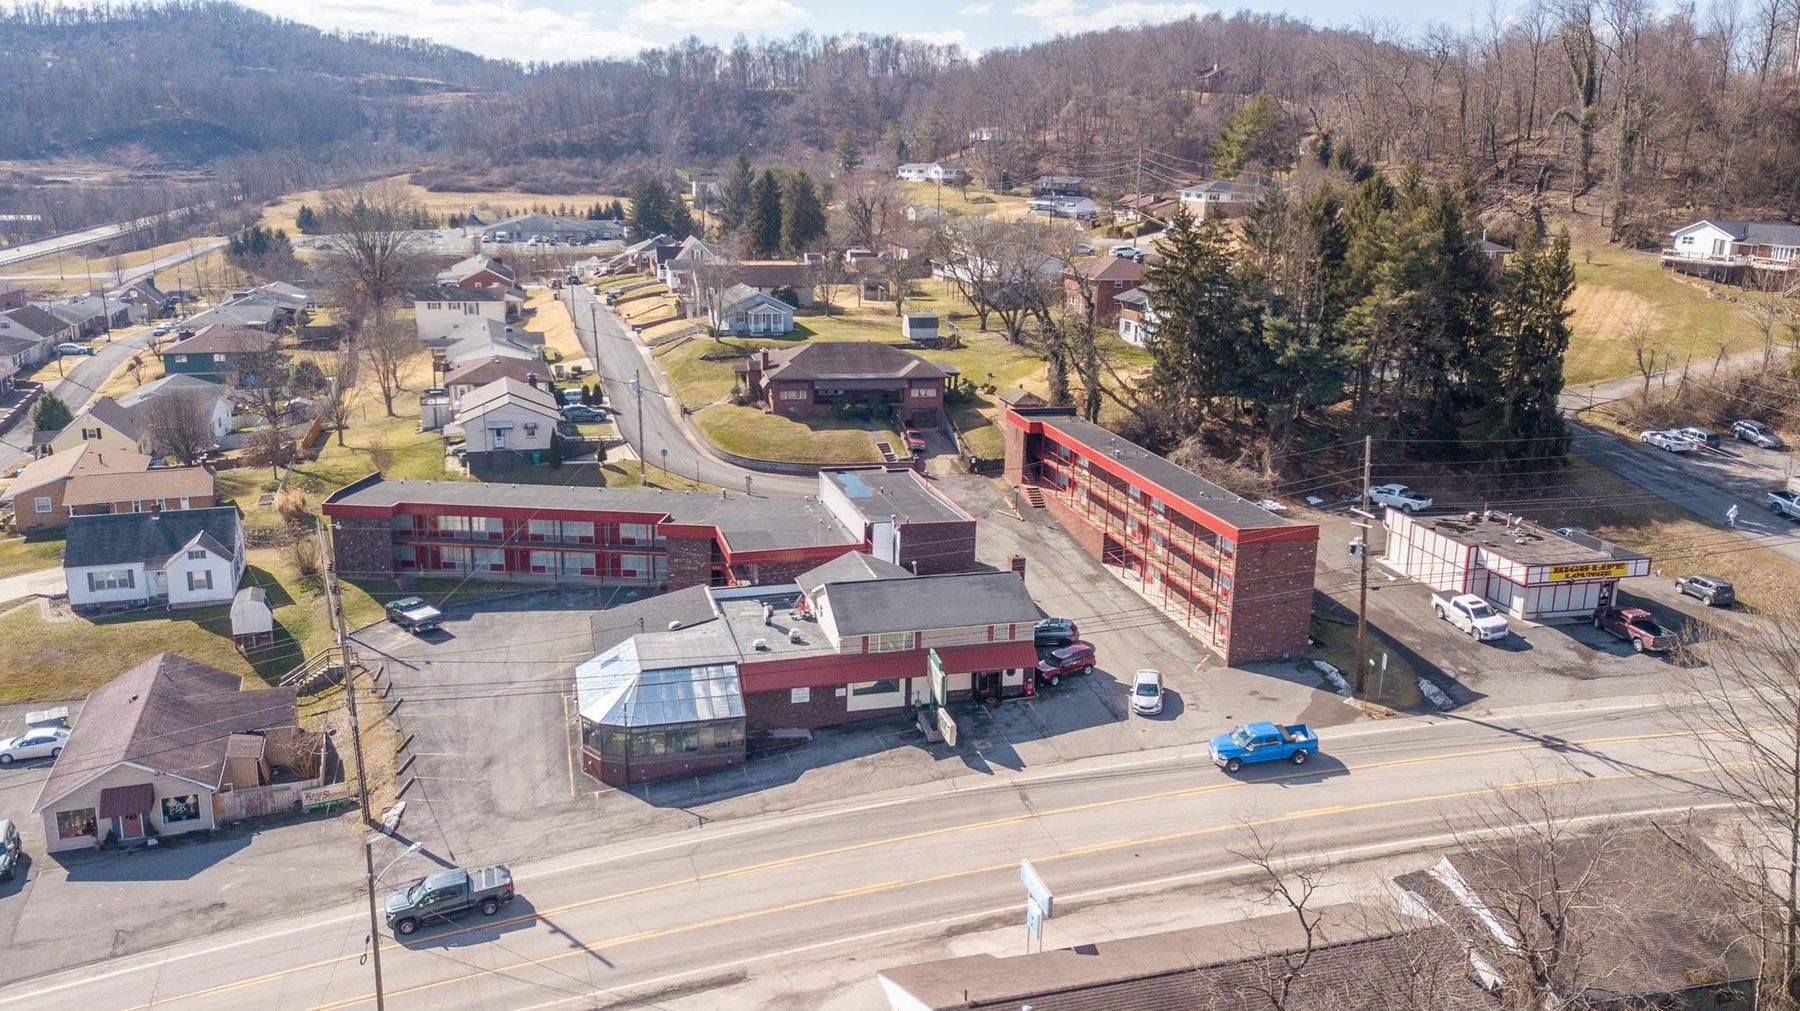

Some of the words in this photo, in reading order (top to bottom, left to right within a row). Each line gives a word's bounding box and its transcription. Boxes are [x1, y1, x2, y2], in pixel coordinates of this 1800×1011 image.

[1553, 564, 1589, 573] HIGH
[1590, 562, 1626, 571] LIFE
[1565, 570, 1612, 578] LOUNGE
